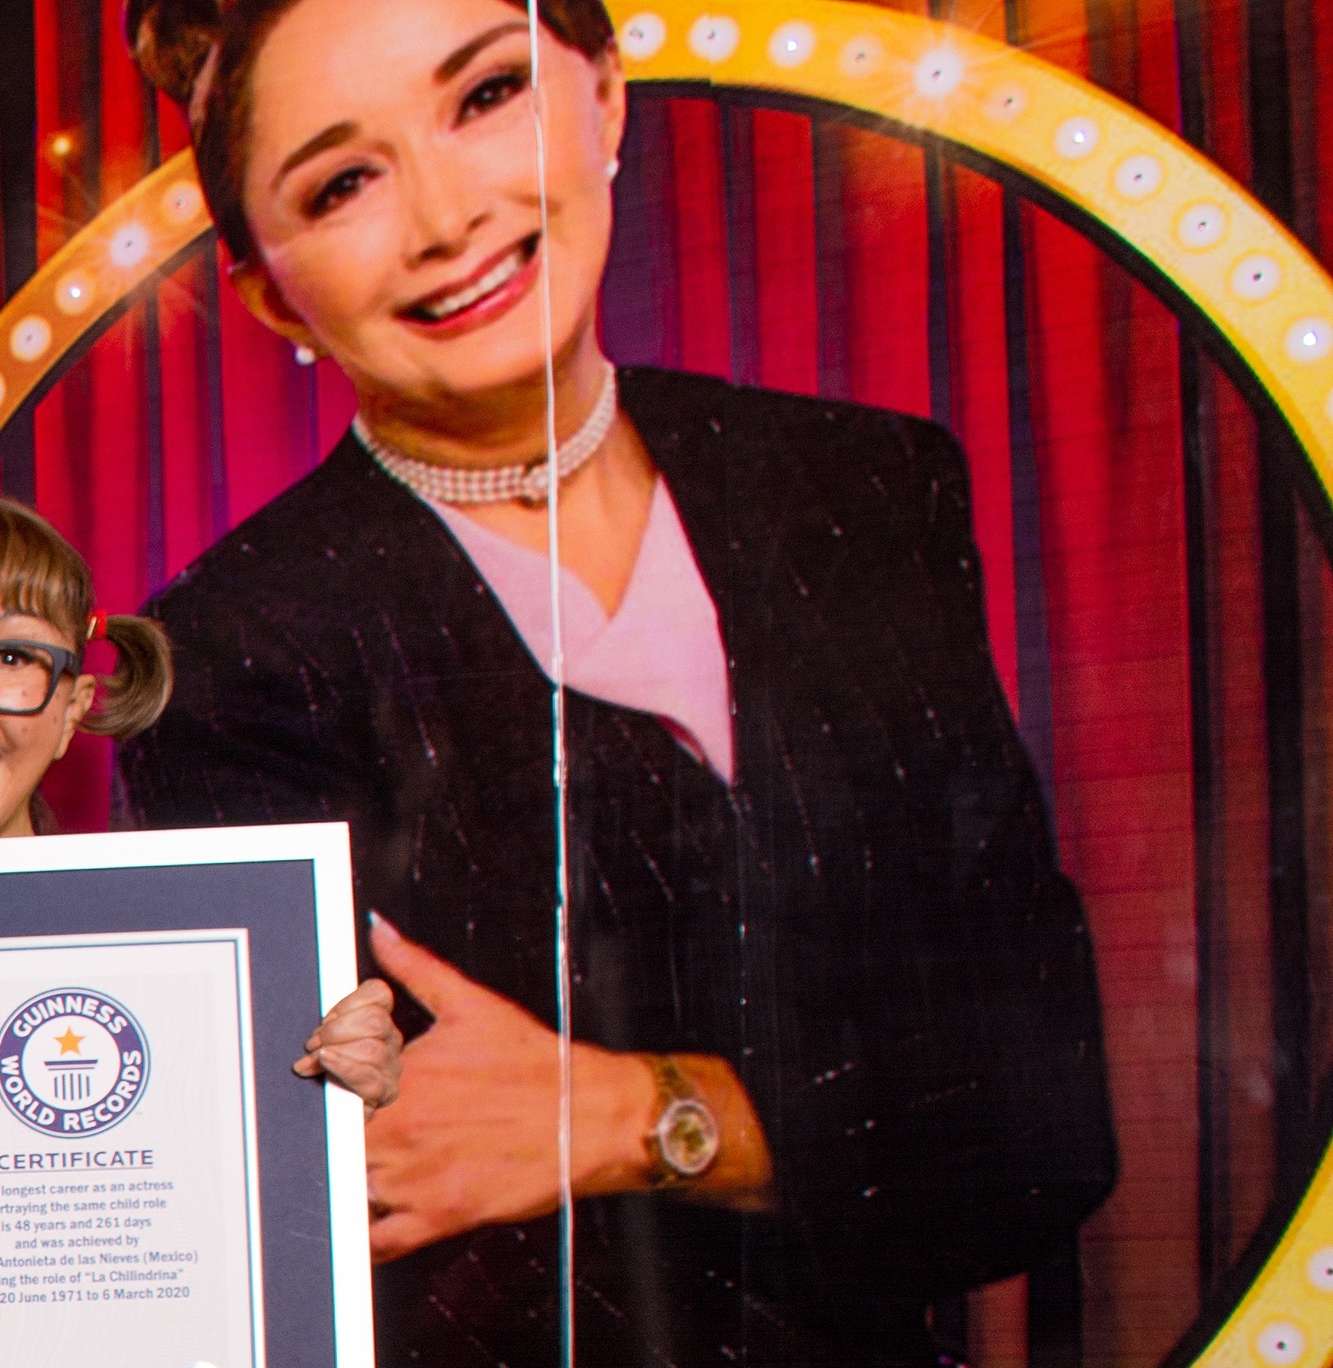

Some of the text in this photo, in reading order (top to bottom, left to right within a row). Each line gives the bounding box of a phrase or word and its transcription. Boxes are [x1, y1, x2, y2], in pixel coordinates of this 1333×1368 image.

[13, 995, 127, 1038] GUINNESS
[1, 1050, 142, 1131] WORLD RECORDS
[1, 1184, 46, 1197] longest
[50, 1183, 89, 1195] career
[93, 1183, 106, 1193] as
[110, 1182, 125, 1192] an
[128, 1180, 174, 1191] actress
[51, 1201, 70, 1212] the
[74, 1202, 106, 1211] same
[110, 1199, 140, 1210] child
[144, 1198, 167, 1209] role
[1, 1216, 152, 1233] is 48 years and 261 days
[15, 1235, 139, 1249] and was achieved by
[60, 1254, 74, 1266] de
[78, 1254, 96, 1265] las
[100, 1253, 139, 1264] Nieves
[143, 1250, 199, 1264] (Mexico)
[20, 1274, 39, 1285] the
[43, 1273, 66, 1284] role
[70, 1272, 82, 1283] of
[0, 1293, 15, 1303] 20
[19, 1292, 47, 1303] June
[51, 1290, 82, 1301] 1971
[87, 1290, 99, 1301] to
[103, 1290, 110, 1300] 6
[114, 1288, 153, 1300] March
[157, 1287, 190, 1298] 2020
